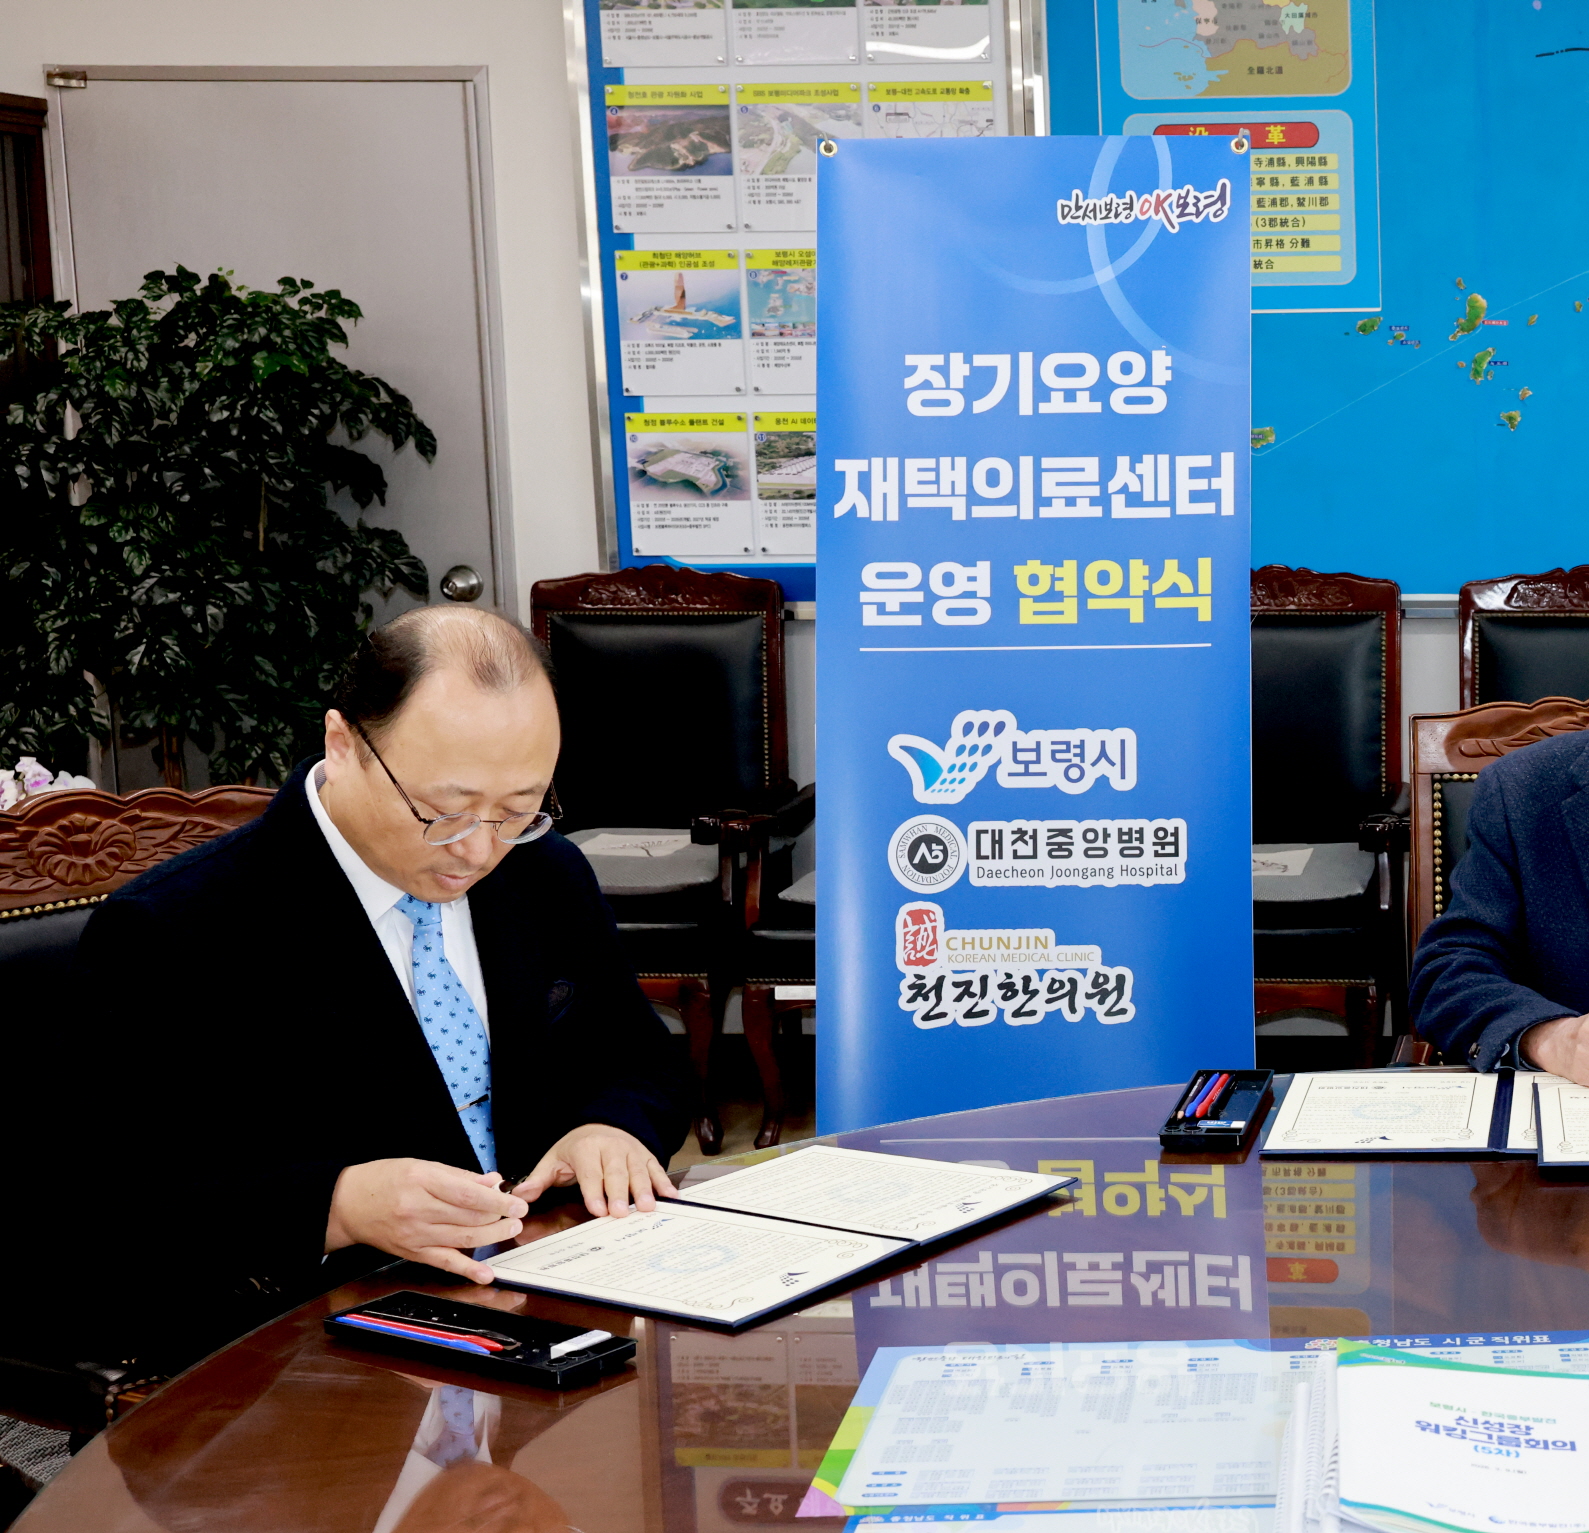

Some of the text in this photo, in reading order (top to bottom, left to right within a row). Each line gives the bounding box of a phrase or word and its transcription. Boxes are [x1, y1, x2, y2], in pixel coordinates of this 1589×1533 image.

[1265, 125, 1286, 145] 革
[904, 350, 1172, 416] 장기요양
[834, 452, 1235, 522] 재택의료센터
[860, 558, 1212, 627] 운영 협약식
[1007, 737, 1127, 784] 보령시
[899, 825, 957, 884] SAMWHAN MEDICAL FOUNDATION
[975, 826, 1180, 860] 대천중앙병원
[977, 862, 1179, 881] Daecheon Joongang Hospital
[946, 935, 1049, 951] CHUNJIN
[947, 951, 1095, 964] KOREAN MEDICAL CLINIC
[906, 971, 1129, 1022] 천진한의원
[1414, 1420, 1577, 1451] 워킹그룹회의
[1454, 1415, 1534, 1436] 신성장
